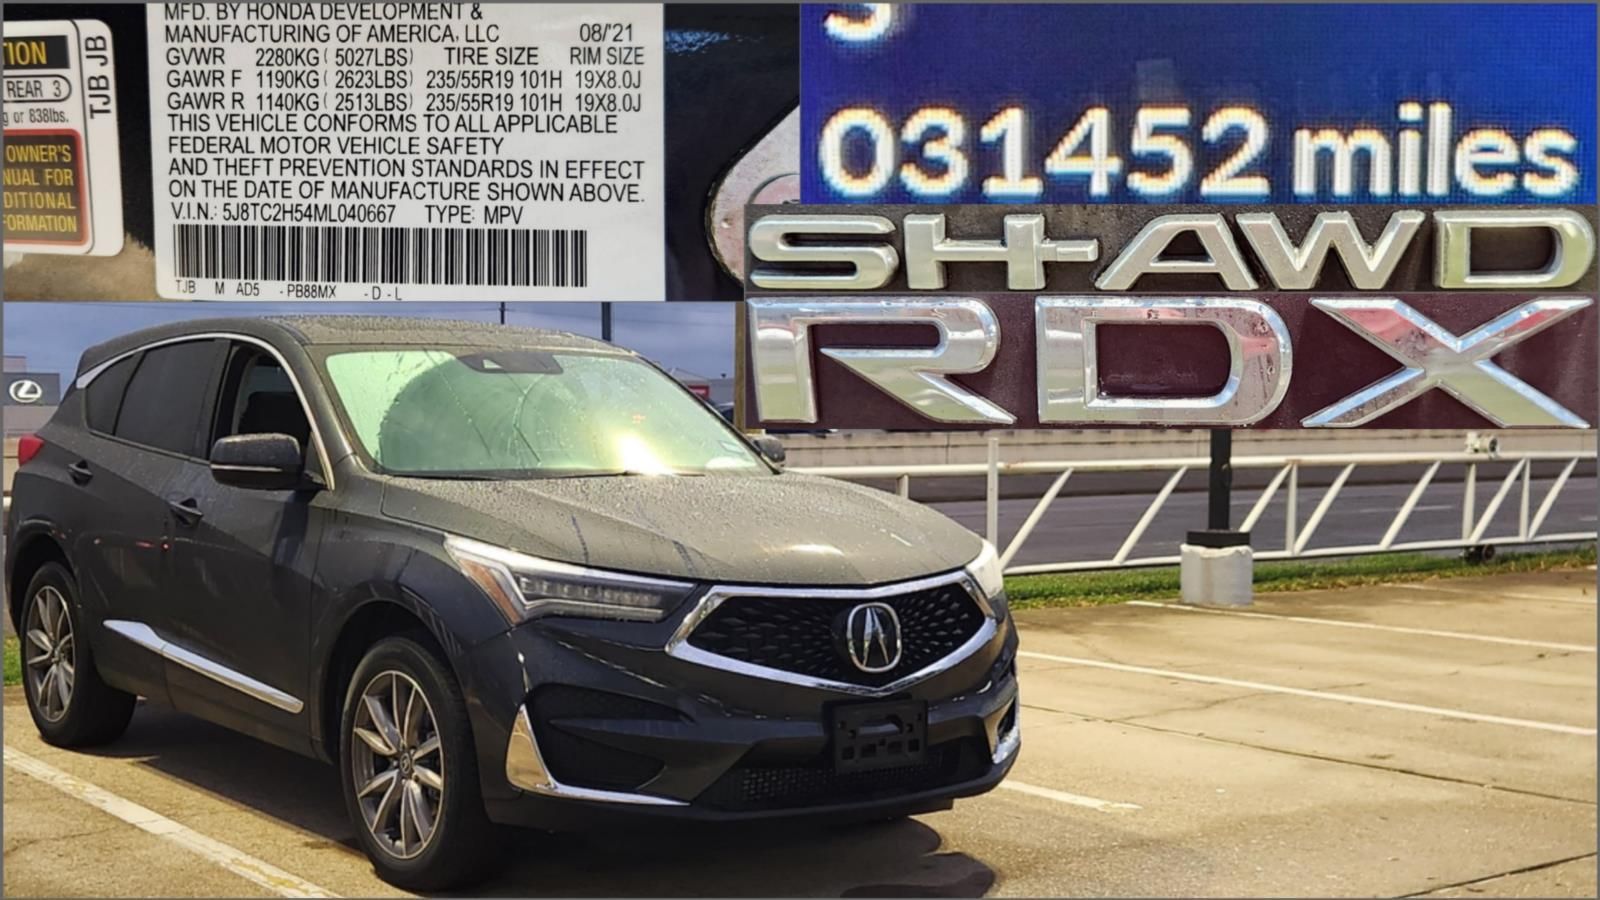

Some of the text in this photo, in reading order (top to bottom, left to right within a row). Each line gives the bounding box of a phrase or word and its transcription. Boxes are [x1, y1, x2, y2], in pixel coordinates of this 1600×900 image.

[165, 3, 483, 20] MFD. BY HONDA DEVELOPMENT &
[165, 24, 499, 43] MANUFACTURING OF AMERICA, LLC
[166, 47, 225, 66] GVWR
[444, 47, 538, 65] TIRE SIZE
[570, 47, 644, 65] RIM SIZE
[167, 70, 224, 88] GAWR
[232, 69, 242, 88] F
[426, 70, 514, 89] 235/55R19
[520, 70, 562, 89] 101H
[576, 70, 641, 89] 19X8.0J
[6, 80, 62, 98] REAR 3
[87, 75, 112, 120] TJB
[167, 92, 225, 110] GAWR
[232, 92, 245, 110] R
[426, 93, 513, 112] 235/55R19
[520, 93, 562, 112] 101H
[576, 93, 641, 112] 19X8.0J
[13, 111, 24, 123] or
[167, 113, 617, 133] THIS VEHICLE CONFORMS TO ALL APPLICABLE
[6, 144, 72, 163] OWNER'S
[169, 136, 504, 155] FEDERAL MOTOR VEHICLE SAFETY
[817, 101, 1580, 197] 031452 miles
[44, 168, 74, 187] FOR
[169, 158, 645, 179] AND THEFT PREVENTION STANDARDS IN EFFECT
[169, 179, 644, 202] ON THE DATE OF MANUFACTURE SHOWN ABOVE.
[223, 202, 396, 223] 5J8TC2H54ML040667
[424, 205, 474, 224] TYPE:
[484, 205, 523, 224] MPV
[176, 280, 195, 293] TJB
[215, 281, 224, 294] M
[236, 282, 259, 296] AD5
[747, 295, 1590, 427] RDX
